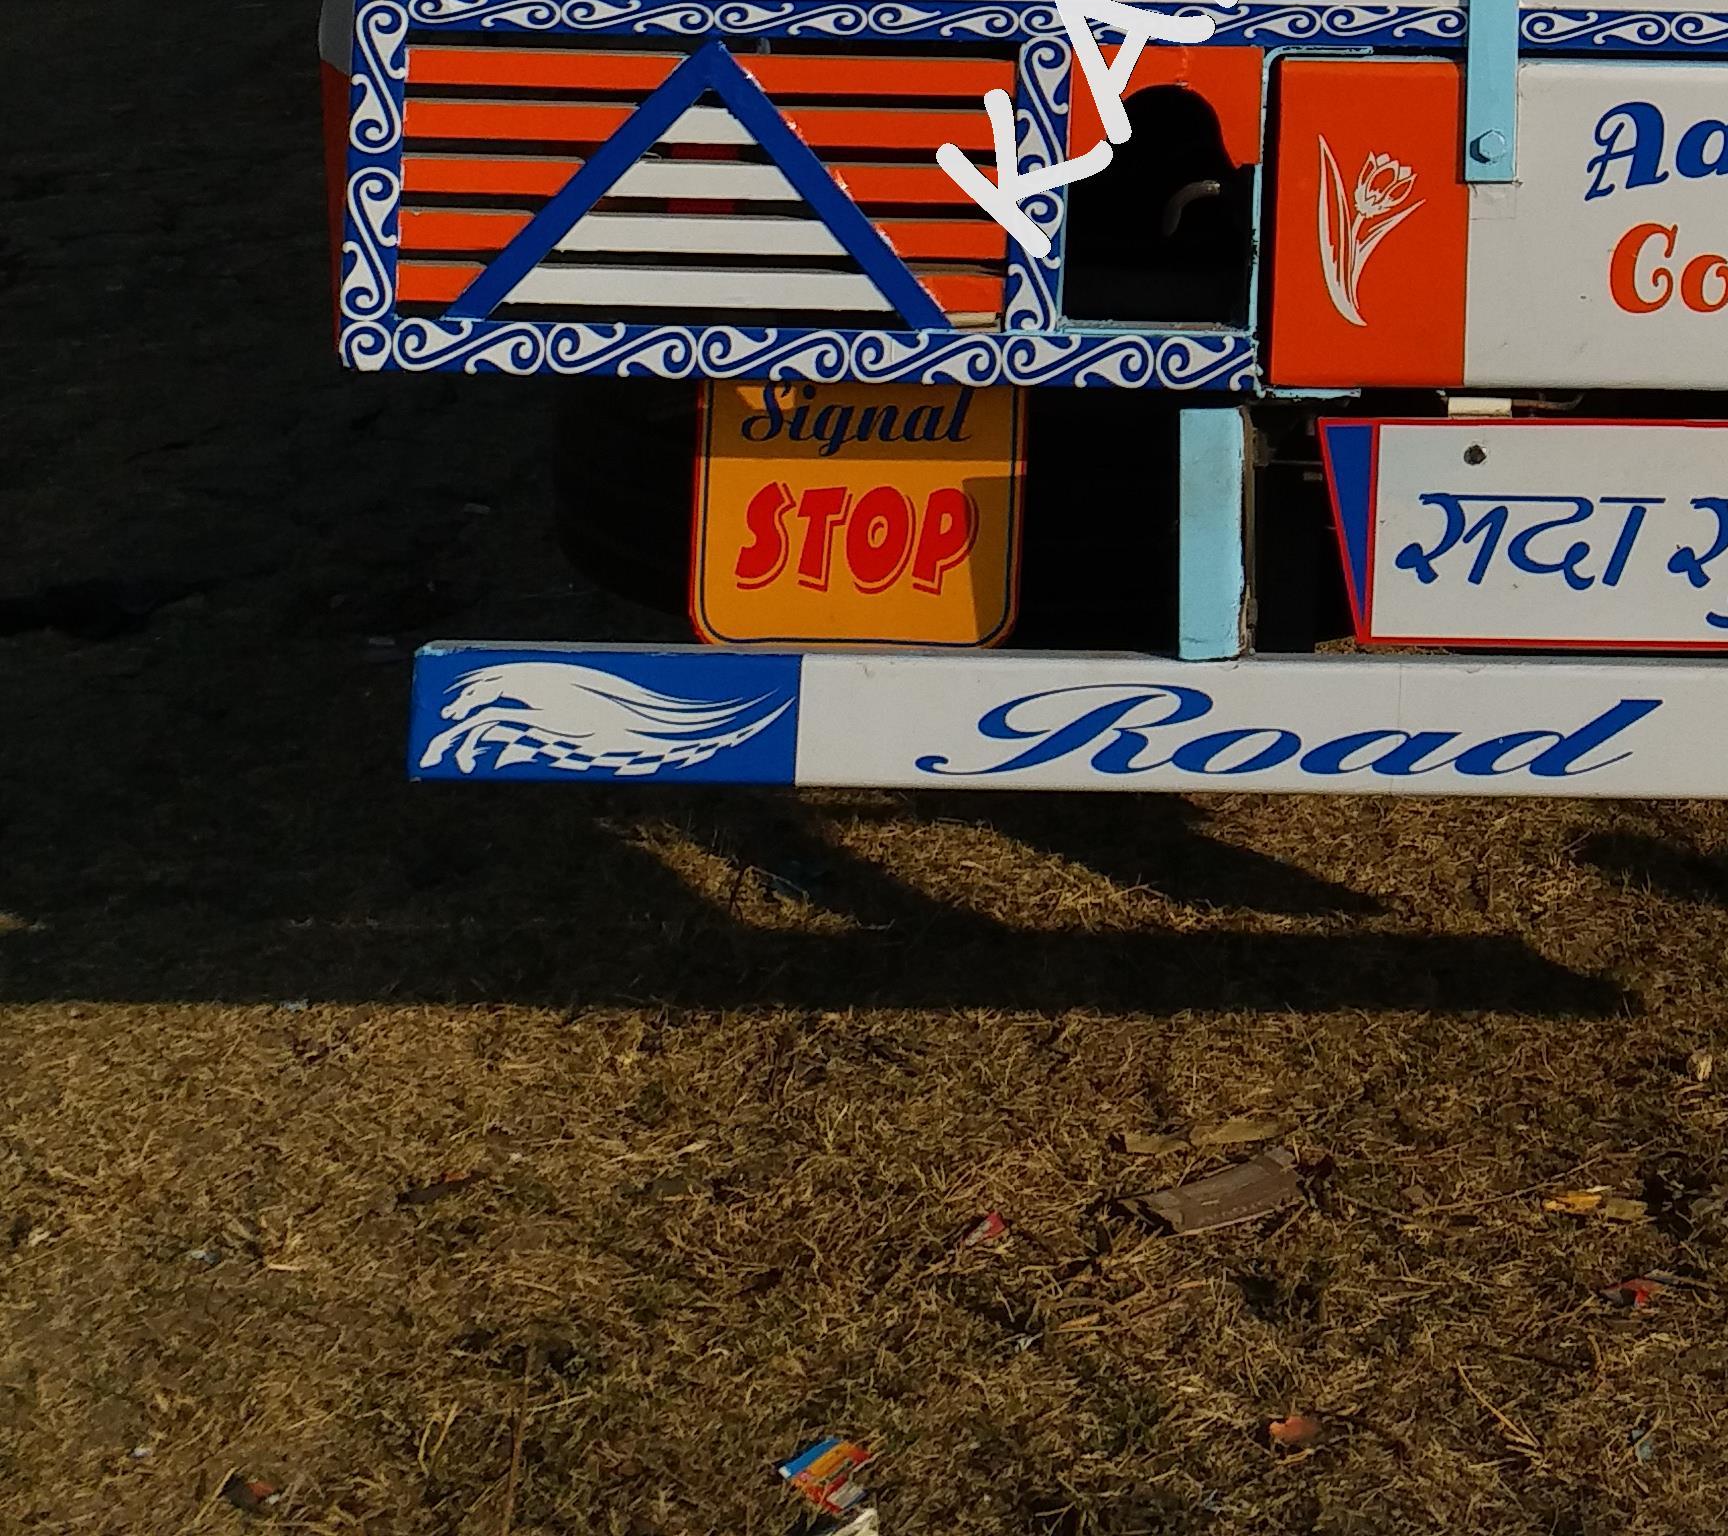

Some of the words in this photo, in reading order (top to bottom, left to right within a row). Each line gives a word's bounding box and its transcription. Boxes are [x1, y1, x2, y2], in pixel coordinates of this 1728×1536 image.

[741, 380, 975, 458] Signal
[735, 481, 977, 595] STOP
[1395, 494, 1666, 590] सदा
[915, 683, 1662, 778] Road
